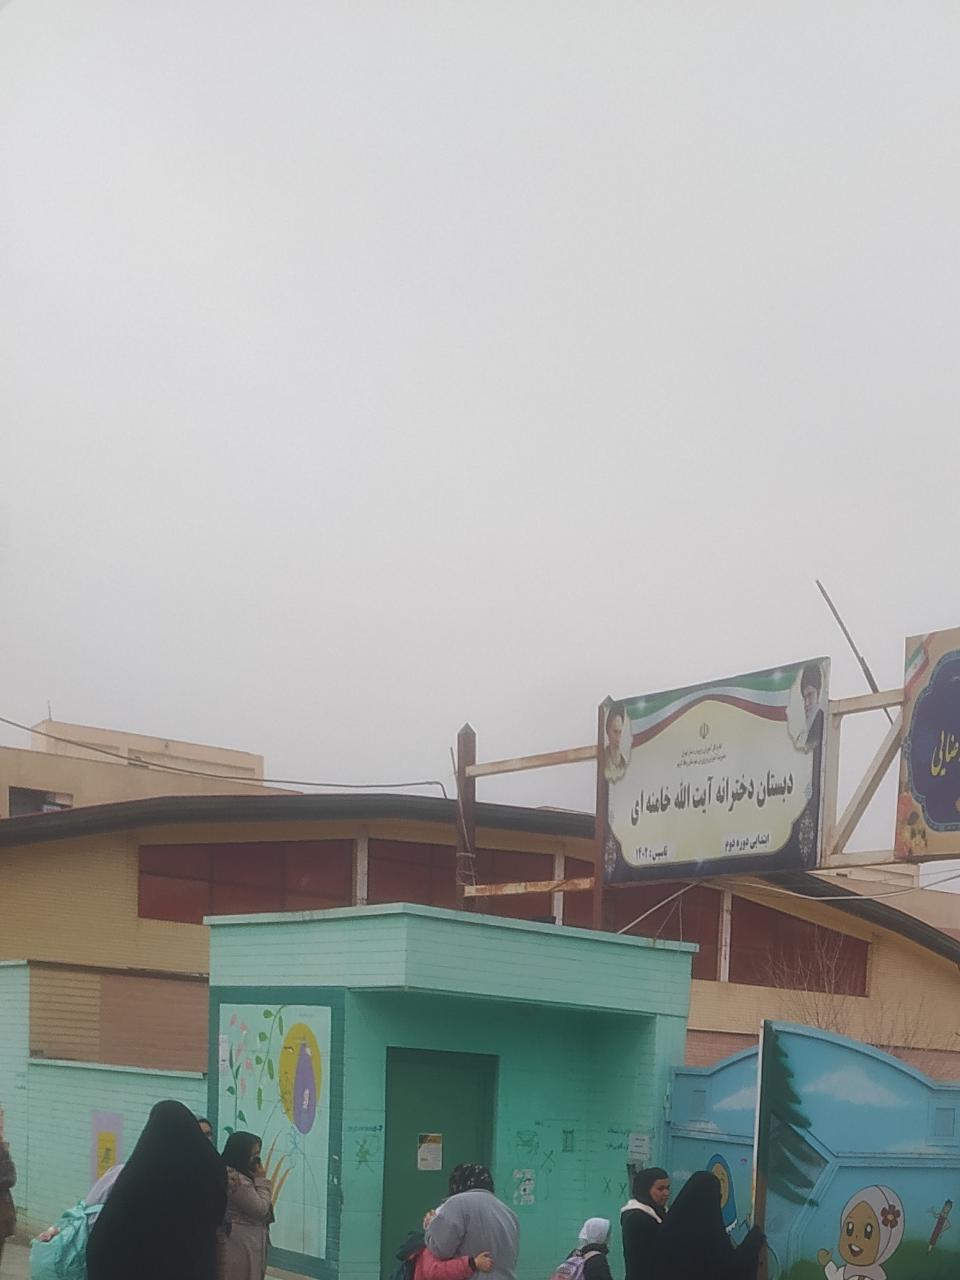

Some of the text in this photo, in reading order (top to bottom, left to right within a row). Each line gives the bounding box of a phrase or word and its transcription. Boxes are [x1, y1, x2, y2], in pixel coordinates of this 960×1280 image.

[631, 769, 794, 826] دبستان دخترانه آیت الله خامنه ای
[724, 839, 736, 853] دوم
[736, 837, 750, 851] دوره
